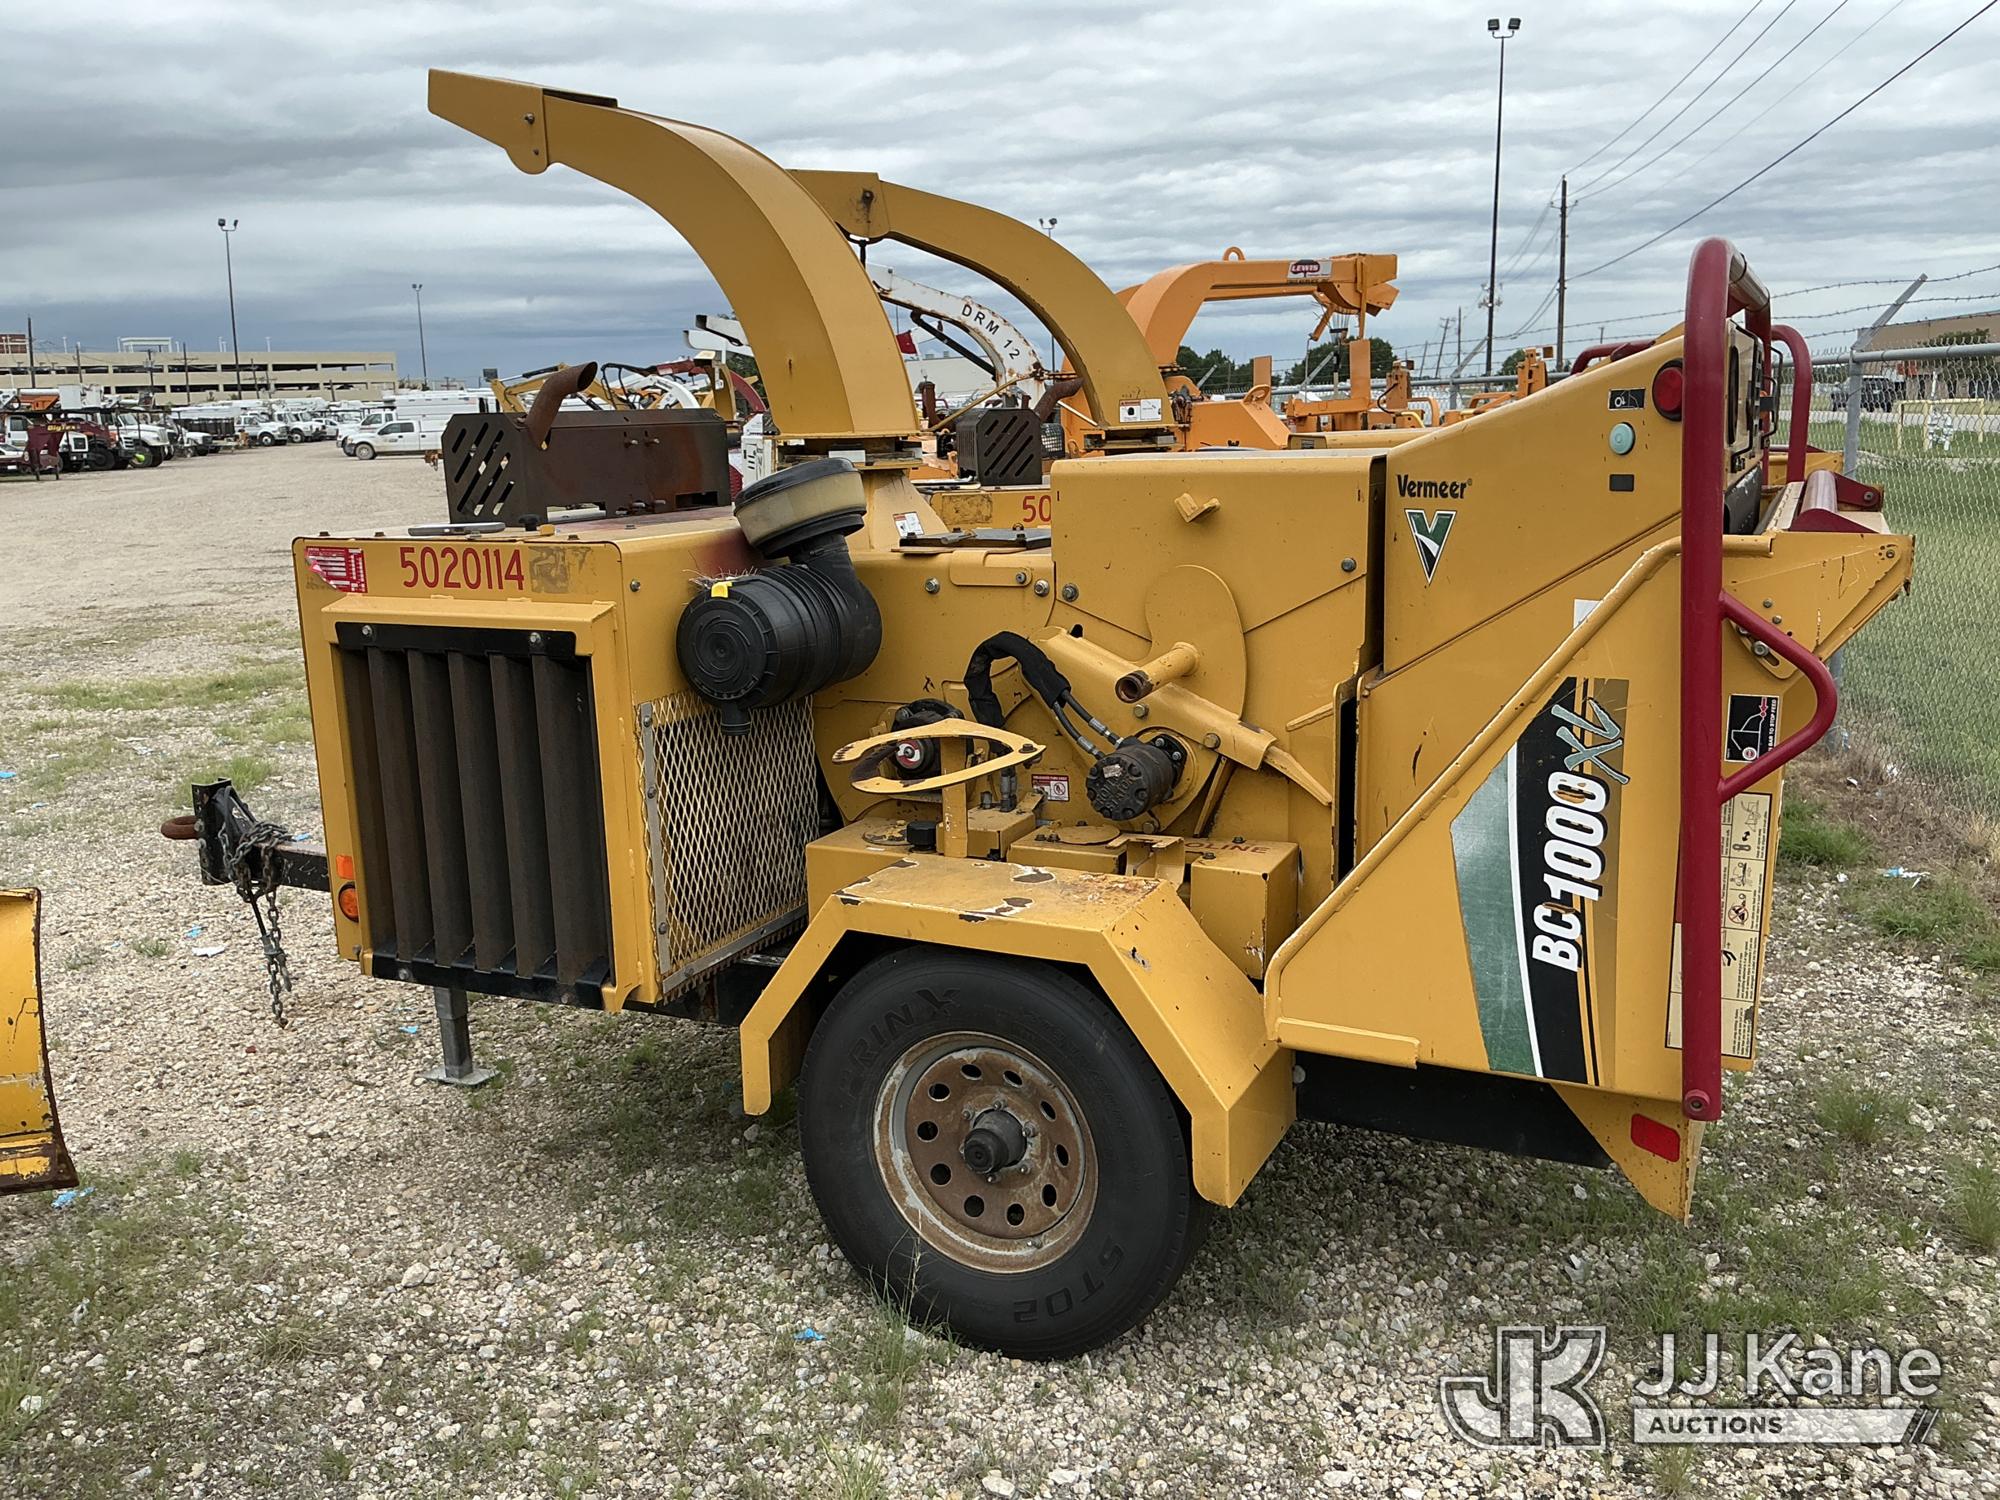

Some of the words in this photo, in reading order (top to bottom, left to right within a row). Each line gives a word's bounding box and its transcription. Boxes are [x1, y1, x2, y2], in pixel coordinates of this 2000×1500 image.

[961, 304, 1000, 335] DRM
[1003, 339, 1020, 360] 12
[1397, 474, 1467, 499] Vermeer
[399, 546, 524, 590] 5020114
